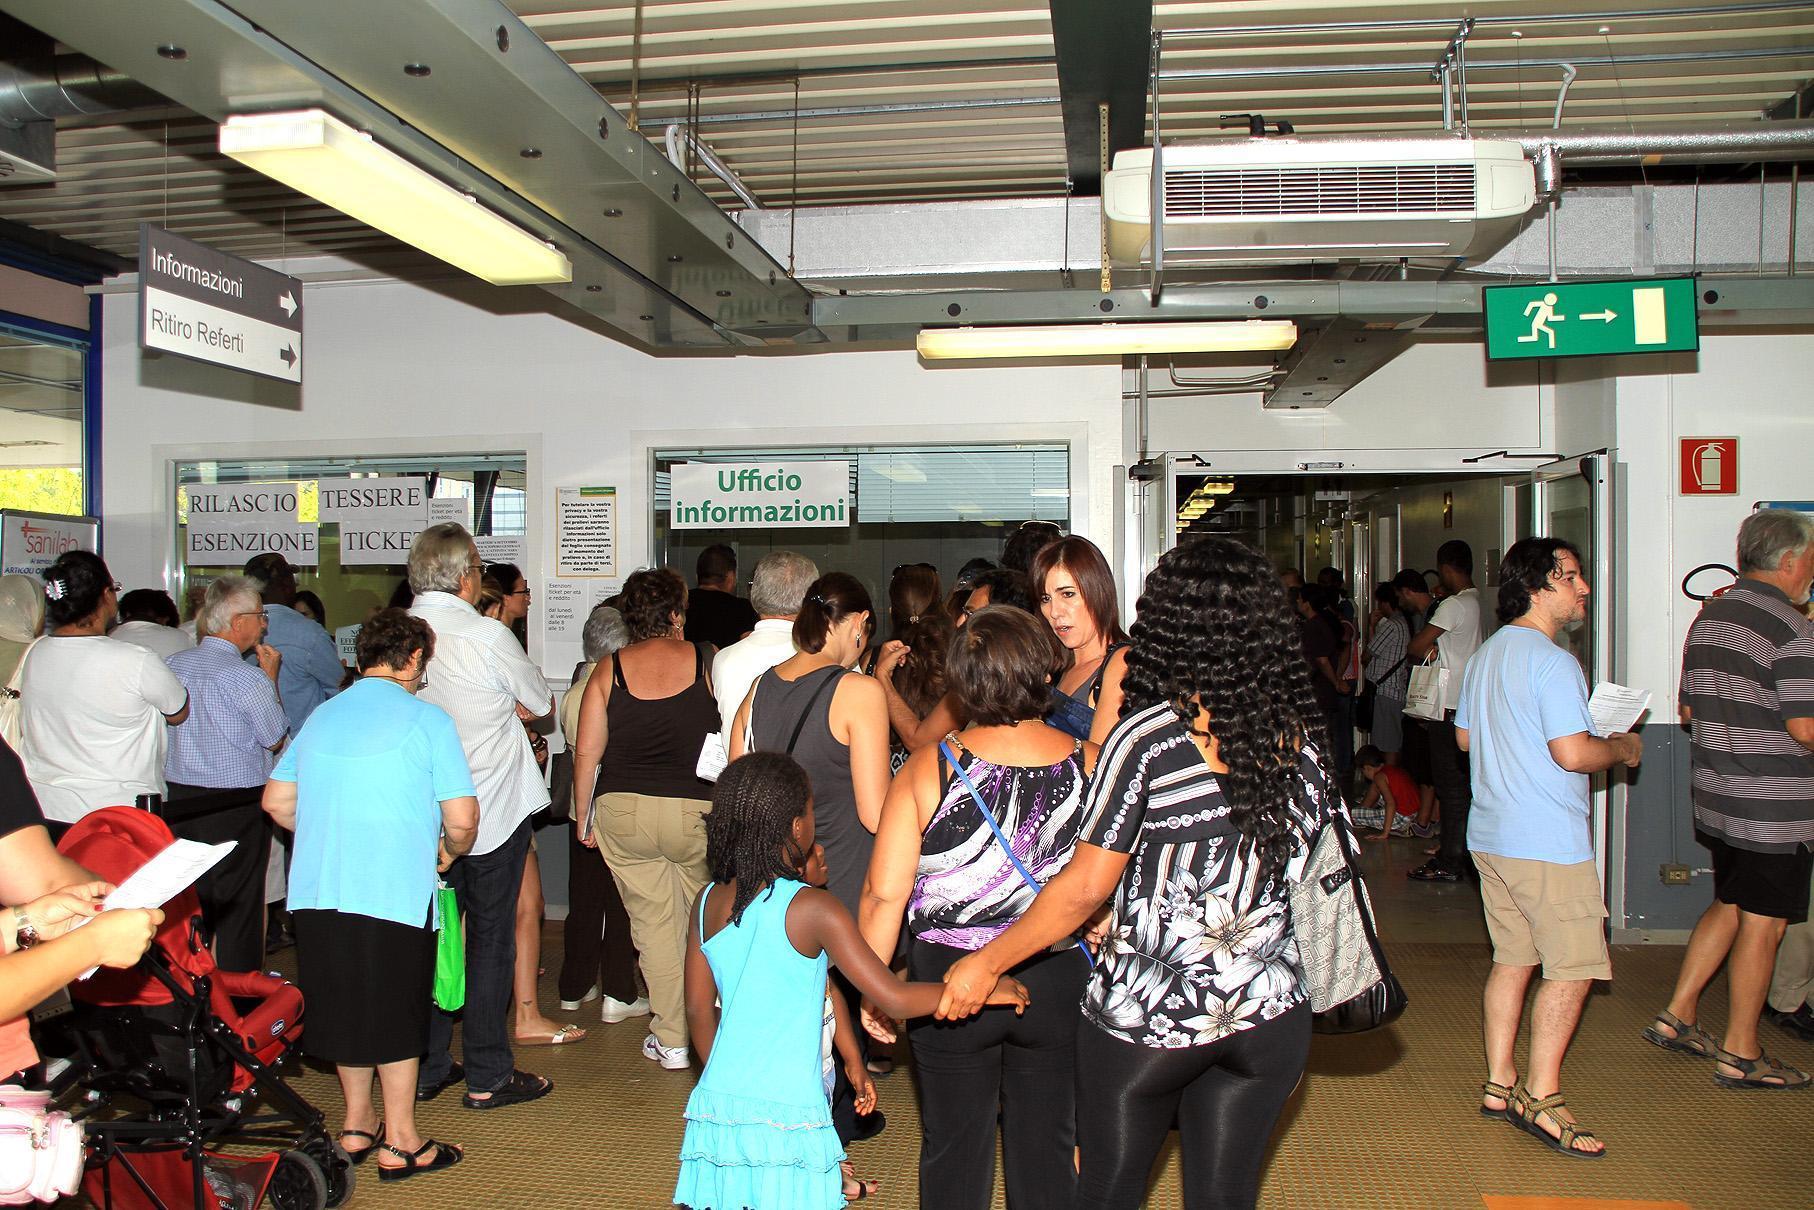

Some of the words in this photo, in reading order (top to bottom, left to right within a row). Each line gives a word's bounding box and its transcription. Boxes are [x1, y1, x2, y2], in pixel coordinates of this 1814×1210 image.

[152, 247, 243, 298] Informazioni
[152, 308, 192, 339] Ritiro
[197, 321, 244, 353] Referti
[718, 468, 802, 493] Ufficio
[190, 493, 297, 513] RILASCIO
[321, 487, 421, 509] TESSERE
[676, 498, 845, 523] informazioni
[26, 530, 78, 554] sanilab
[191, 531, 315, 552] ESENZIONE
